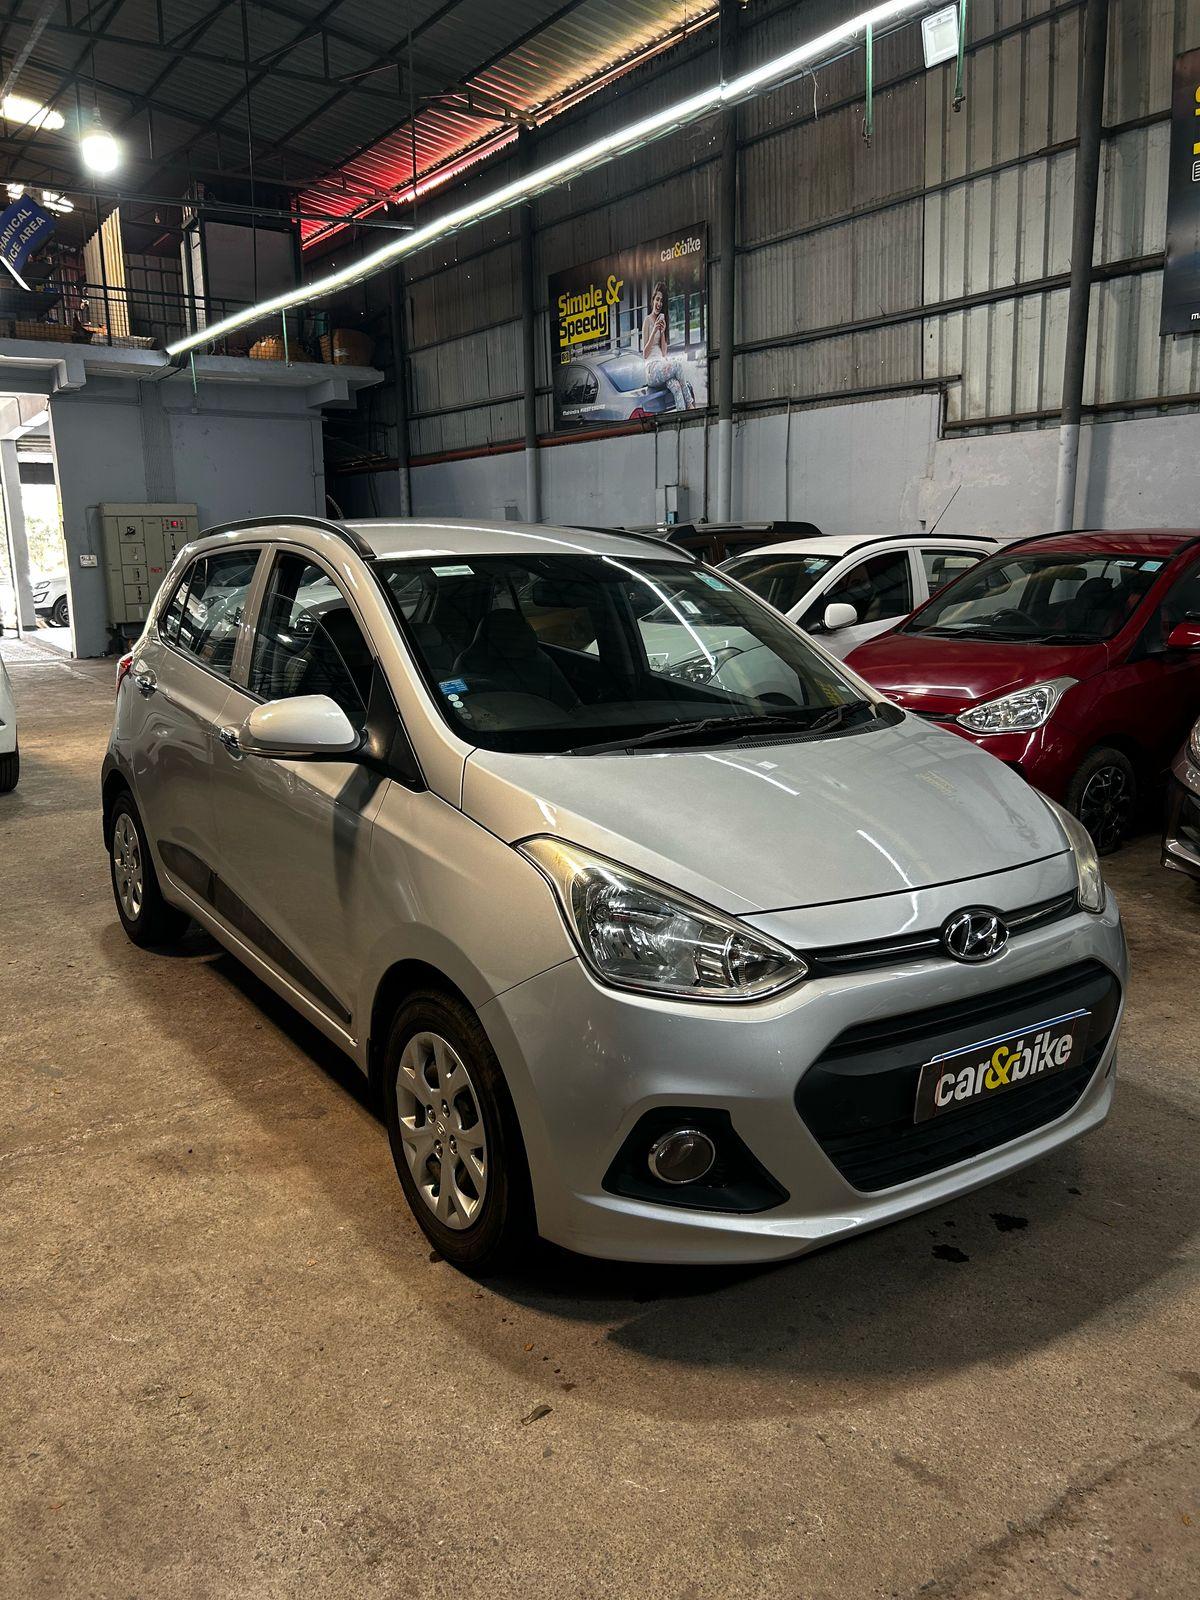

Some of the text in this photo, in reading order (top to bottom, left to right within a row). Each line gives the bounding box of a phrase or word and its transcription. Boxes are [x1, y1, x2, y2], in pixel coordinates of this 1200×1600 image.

[19, 216, 46, 244] AREA
[660, 237, 701, 262] car&bike
[558, 275, 624, 317] Simple &
[559, 308, 608, 343] Speedy
[934, 1031, 1073, 1107] car&bike
